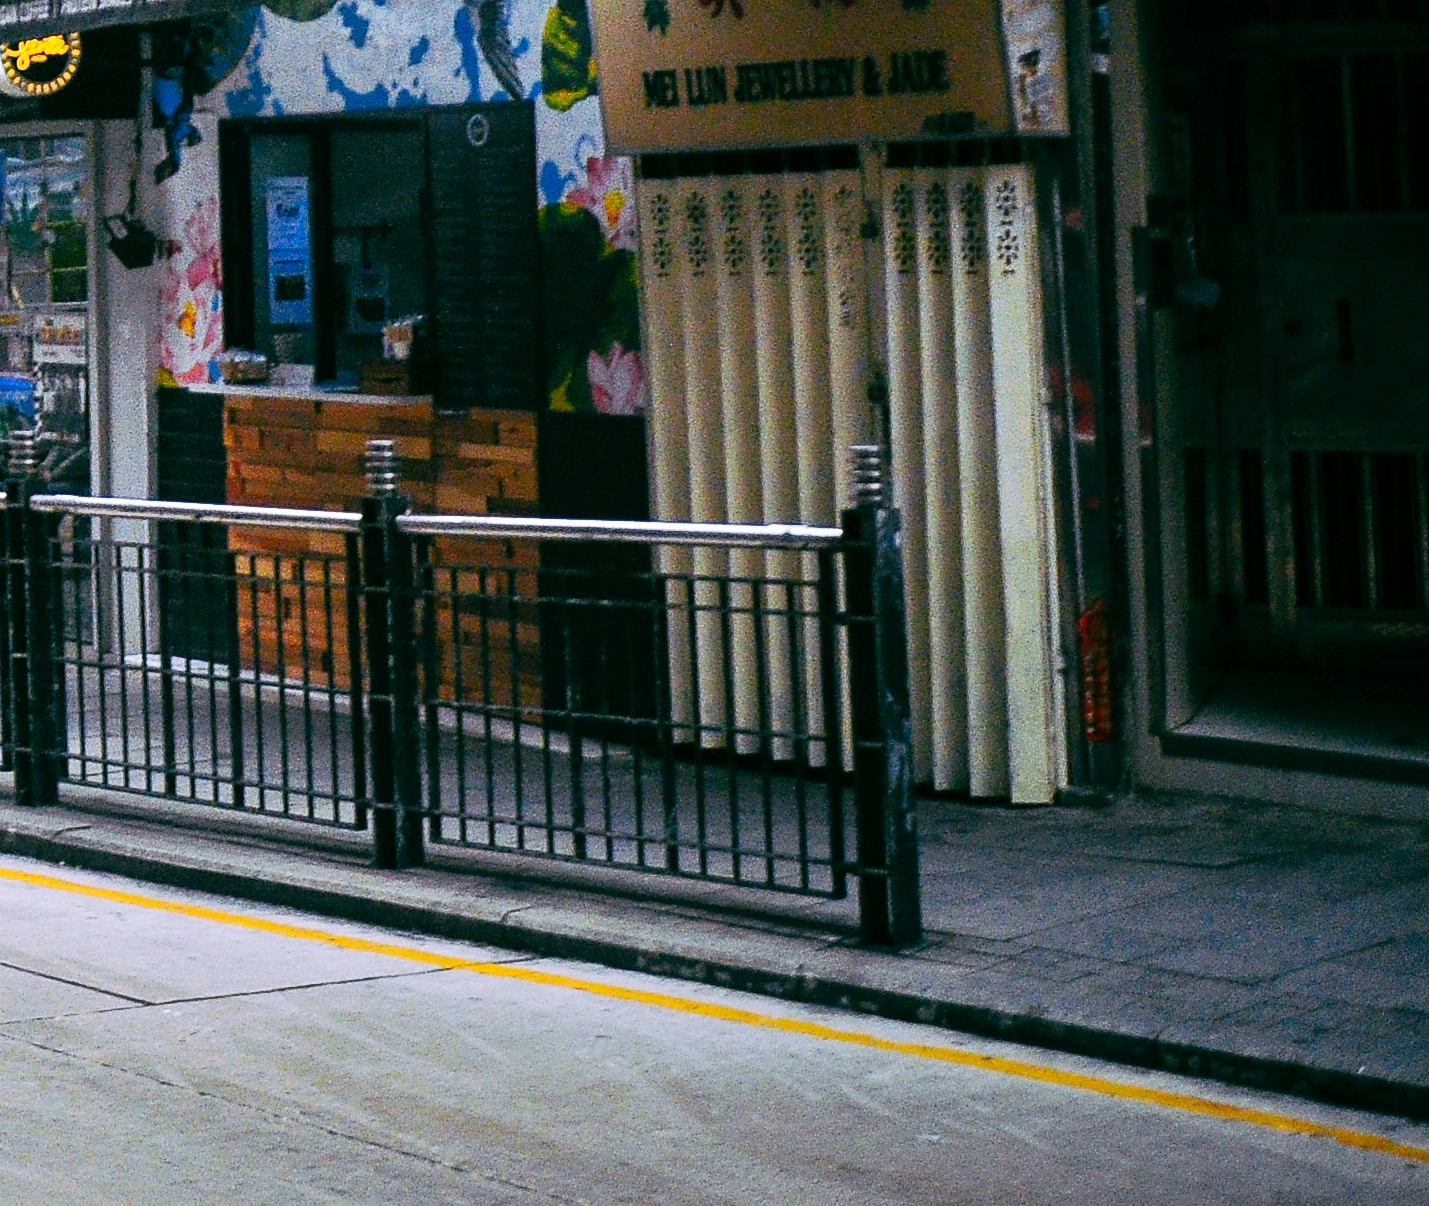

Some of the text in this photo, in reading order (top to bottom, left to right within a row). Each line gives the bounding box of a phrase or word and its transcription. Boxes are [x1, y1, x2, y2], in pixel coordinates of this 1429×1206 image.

[641, 49, 951, 107] MEI LUN JEWELLERY & JADE
